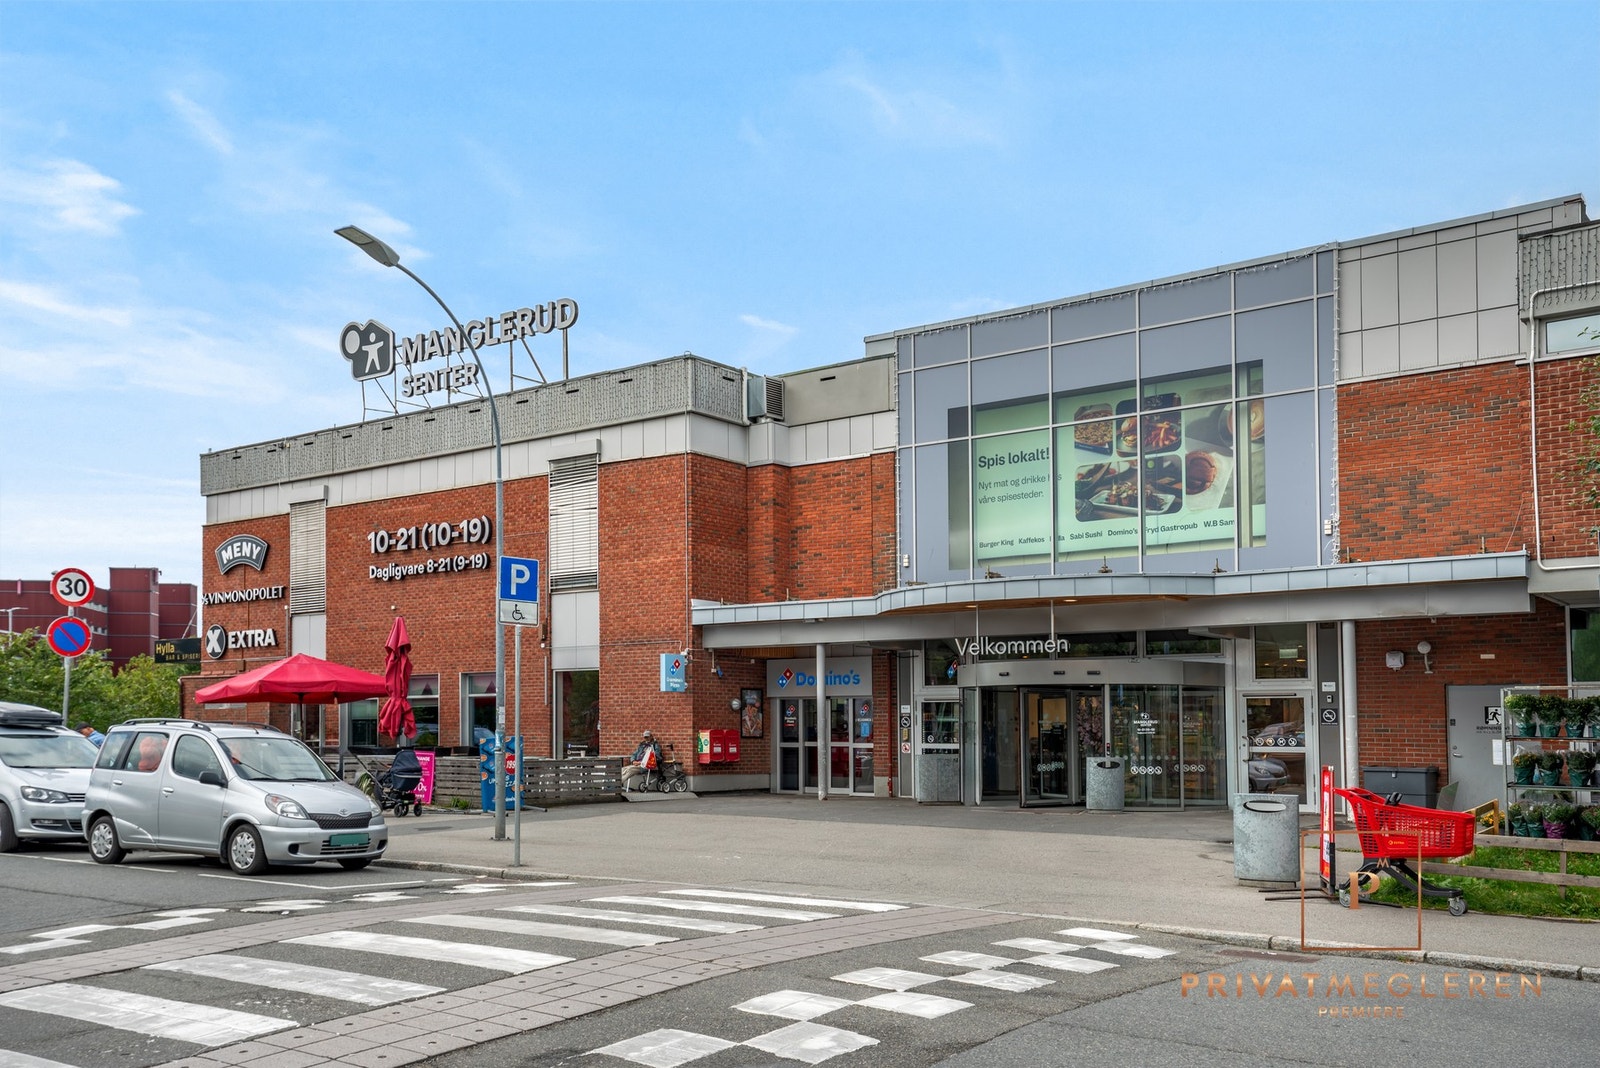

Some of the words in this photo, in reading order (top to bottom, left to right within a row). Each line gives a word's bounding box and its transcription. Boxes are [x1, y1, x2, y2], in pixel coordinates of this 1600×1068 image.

[402, 298, 578, 366] MANGLERUD
[402, 362, 479, 398] SENTER
[978, 454, 1005, 469] Spis
[1008, 447, 1050, 464] lokalt!
[978, 481, 992, 491] Nyt
[993, 479, 1008, 488] mat
[1010, 478, 1020, 487] og
[1021, 475, 1046, 485] drikke
[978, 494, 996, 504] våre
[997, 490, 1044, 503] spisesteder.
[367, 526, 418, 554] 10-21
[421, 515, 492, 551] (10-19)
[979, 541, 1000, 549] Burger
[1018, 536, 1045, 544] Kaffekos
[1069, 532, 1084, 540] Sabi
[1085, 530, 1103, 538] Sushi
[1107, 527, 1138, 536] Domino's
[1160, 522, 1198, 533] Gastropub
[1203, 520, 1218, 528] W.B
[221, 541, 261, 564] MENY
[369, 562, 425, 582] Dagligvare
[426, 556, 452, 573] 8-21
[452, 552, 490, 573] (9-19)
[60, 577, 87, 597] 30
[511, 564, 530, 595] P
[208, 586, 284, 604] VINMONOPOLET
[155, 642, 175, 656] Hylla
[228, 628, 276, 649] EXTRA
[955, 636, 1070, 657] Velkommen
